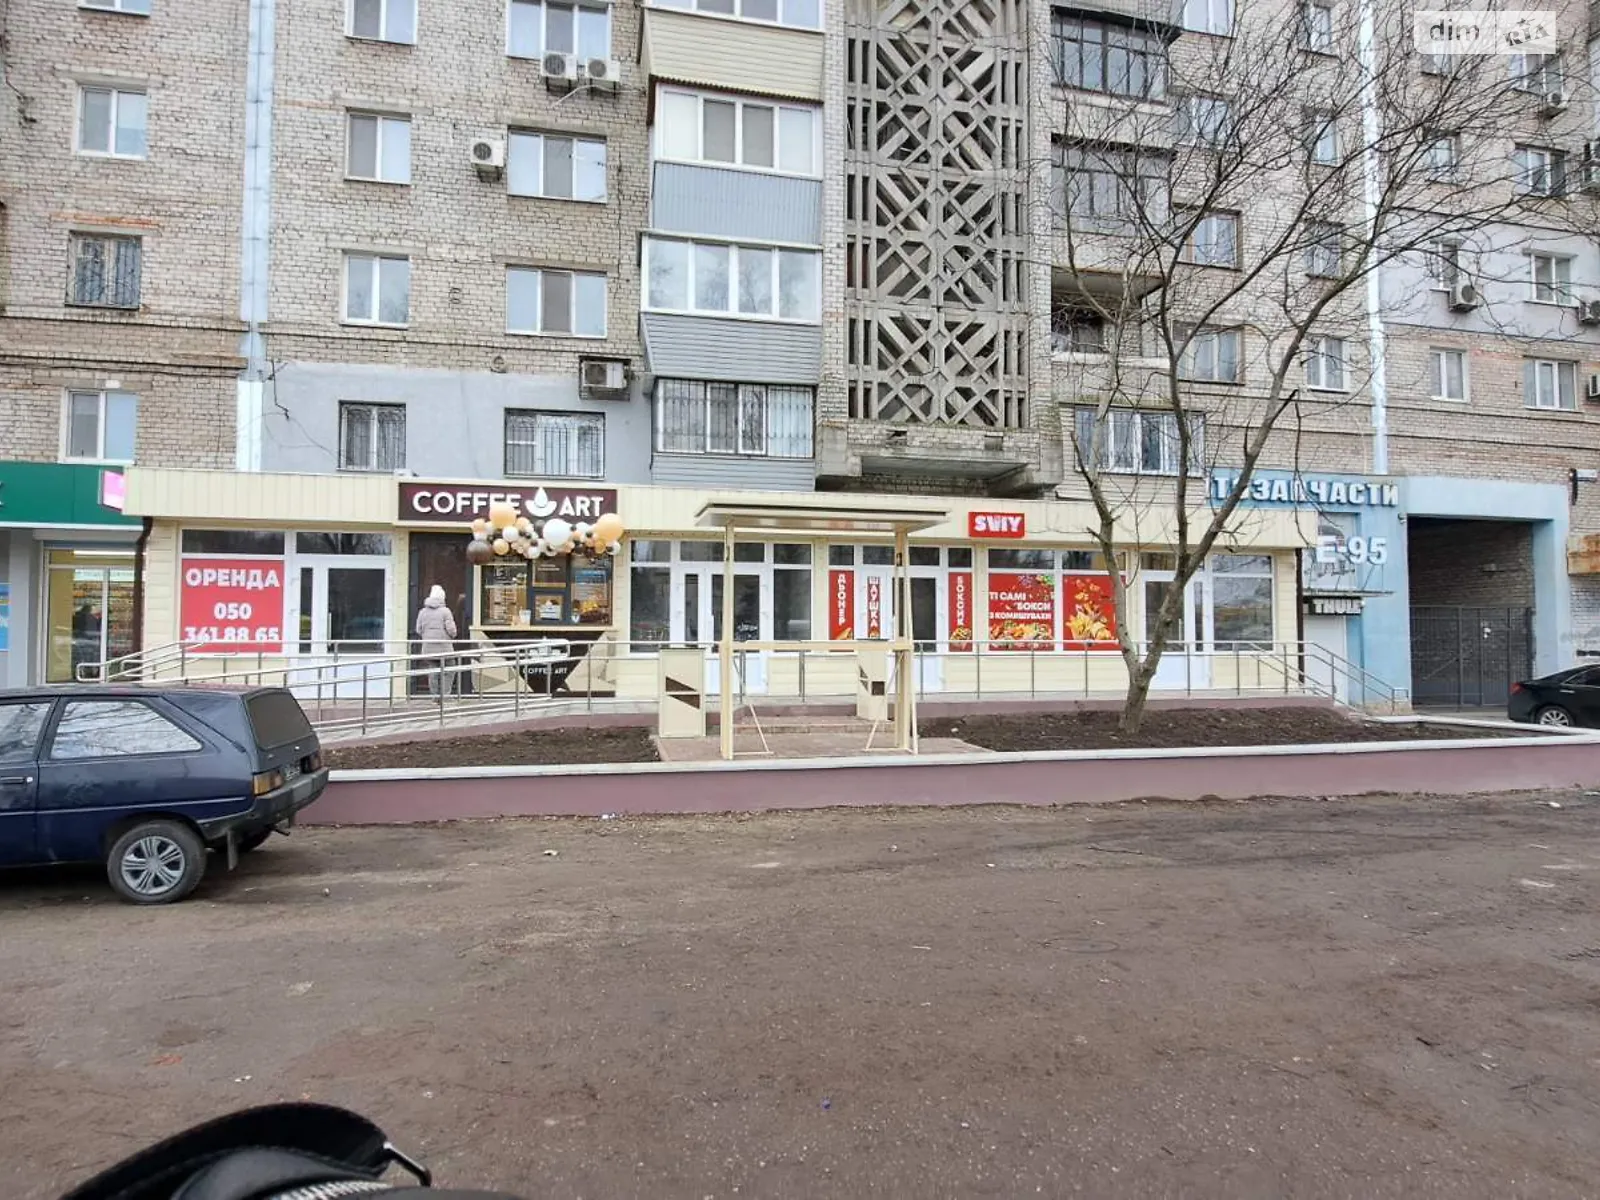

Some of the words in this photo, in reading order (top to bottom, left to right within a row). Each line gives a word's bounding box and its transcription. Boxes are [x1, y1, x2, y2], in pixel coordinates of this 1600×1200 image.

[559, 495, 604, 517] ART
[185, 568, 280, 590] ОРЕНДА
[213, 602, 252, 620] 050
[184, 627, 219, 643] 361
[223, 627, 249, 643] 88
[255, 628, 280, 642] 65
